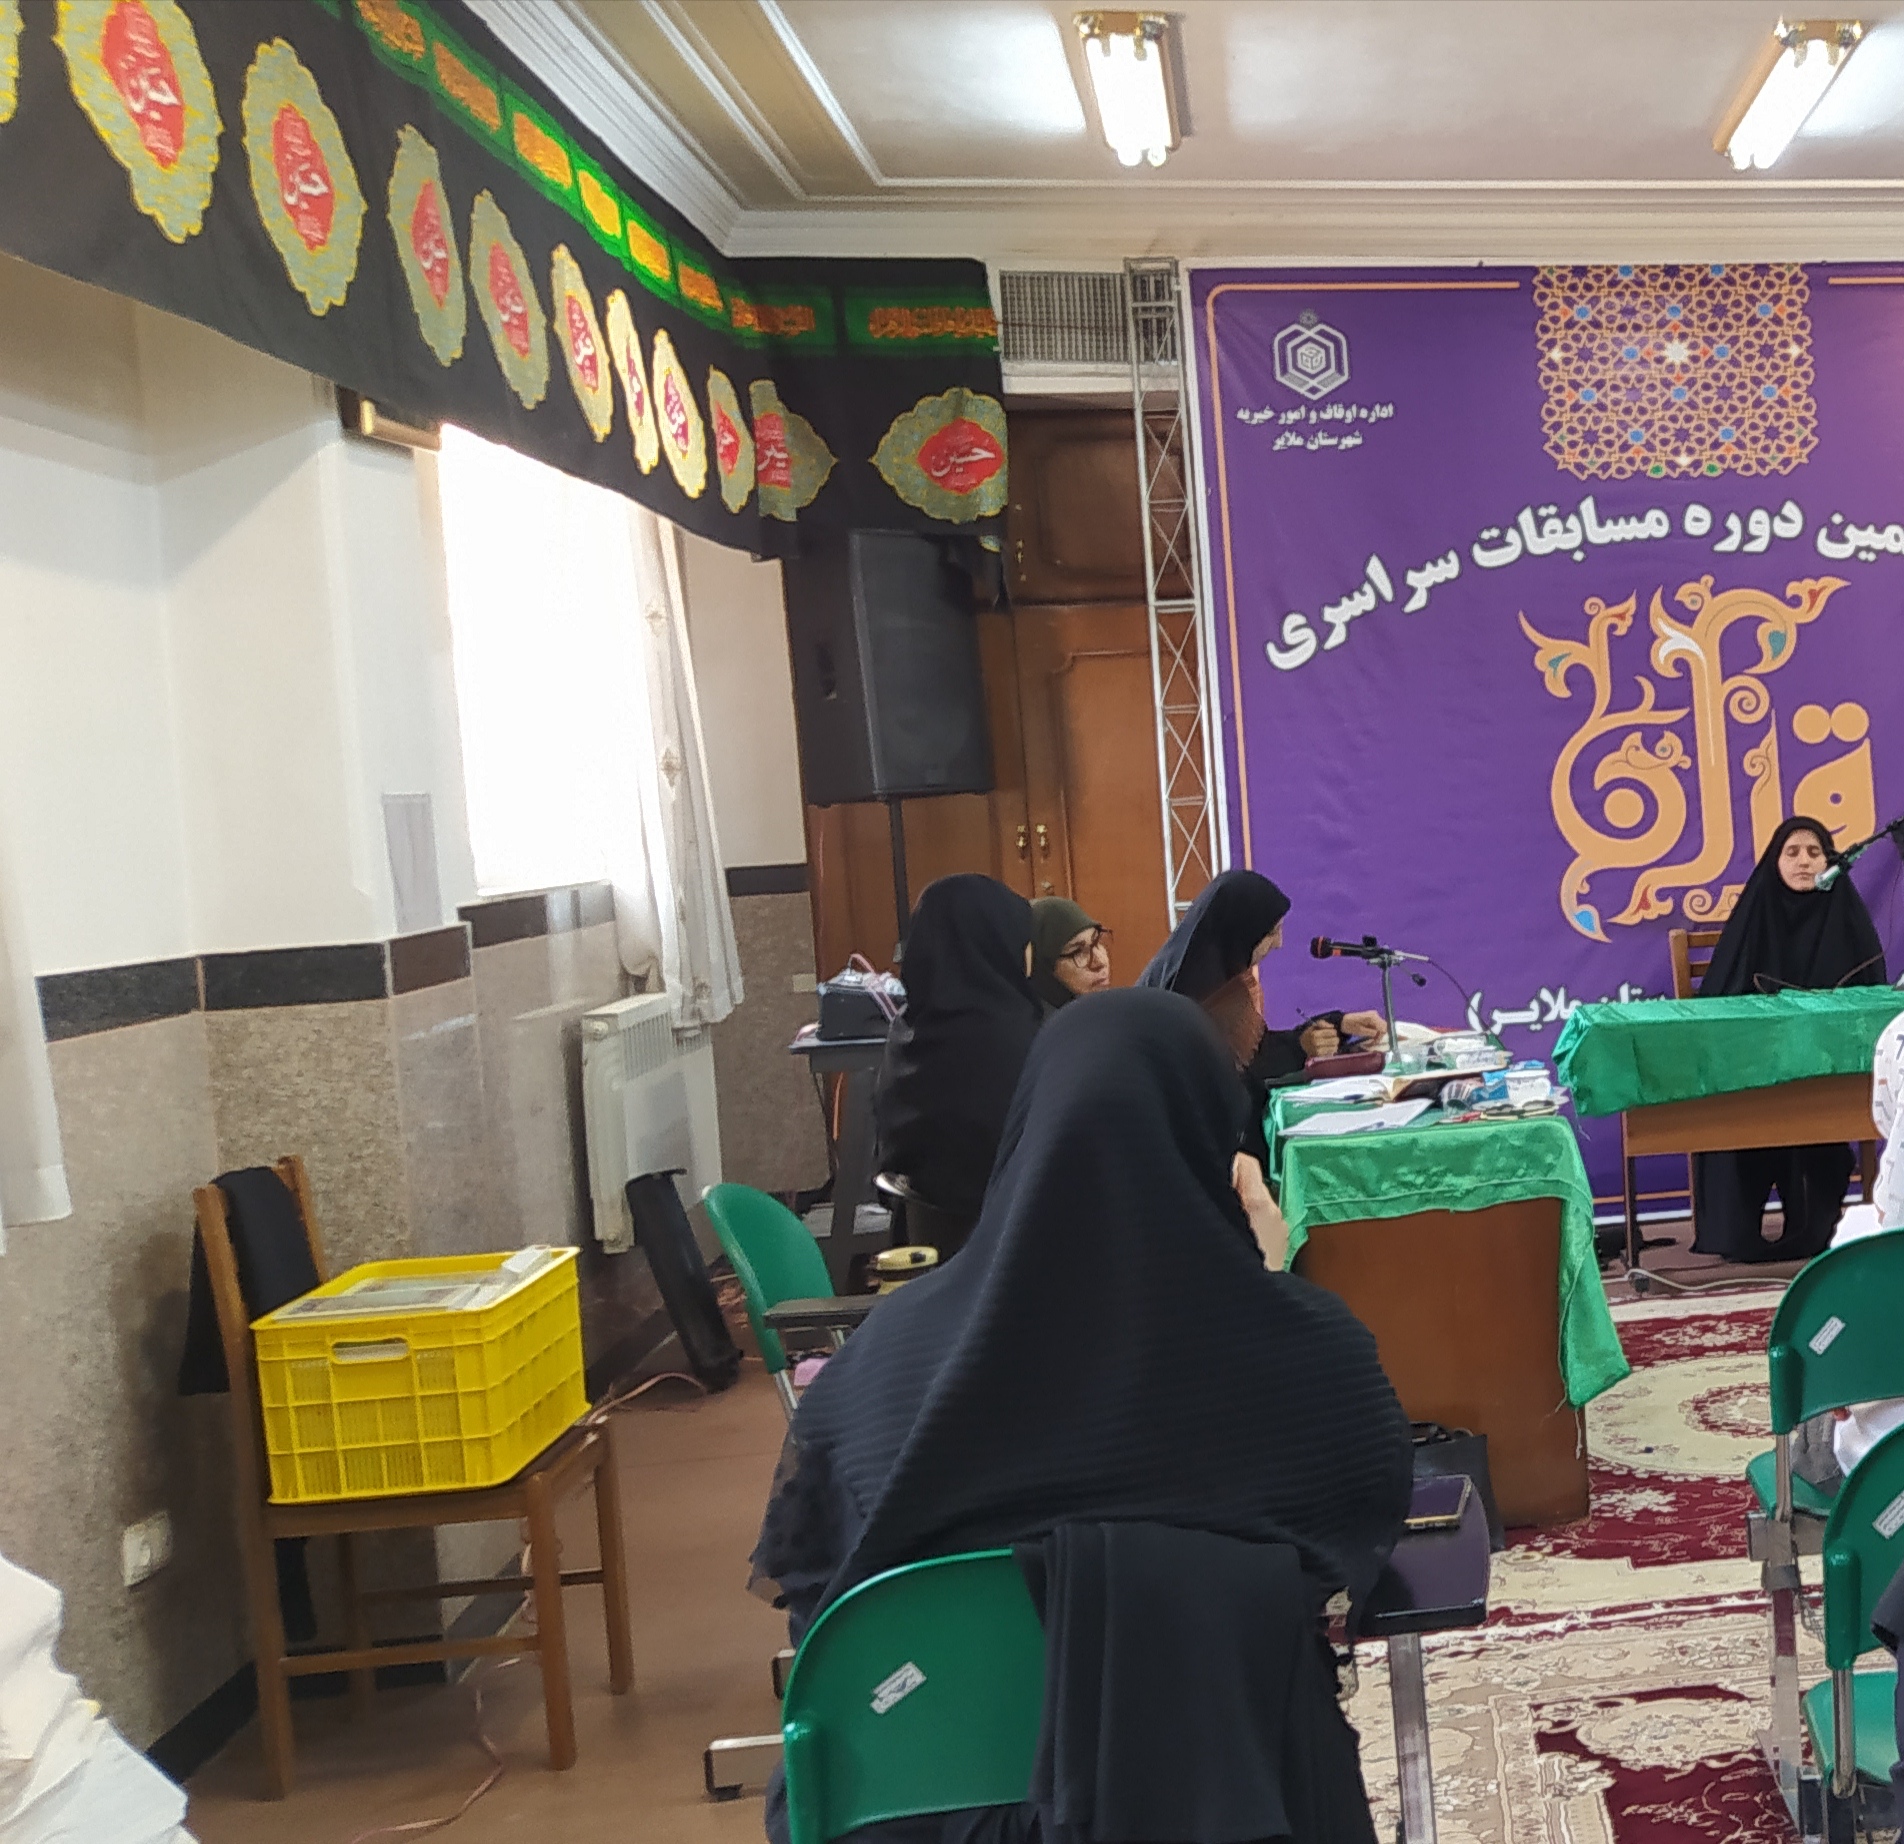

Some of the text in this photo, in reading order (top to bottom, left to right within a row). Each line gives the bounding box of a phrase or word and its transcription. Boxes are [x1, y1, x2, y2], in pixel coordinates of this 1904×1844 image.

[1236, 402, 1395, 426] اداره اوقاف و امور خیریه
[1272, 429, 1364, 452] شهرستان ملایر
[1472, 494, 1671, 568] مسابقات
[1683, 499, 1803, 554] دوره
[1265, 548, 1461, 671] سراسری
